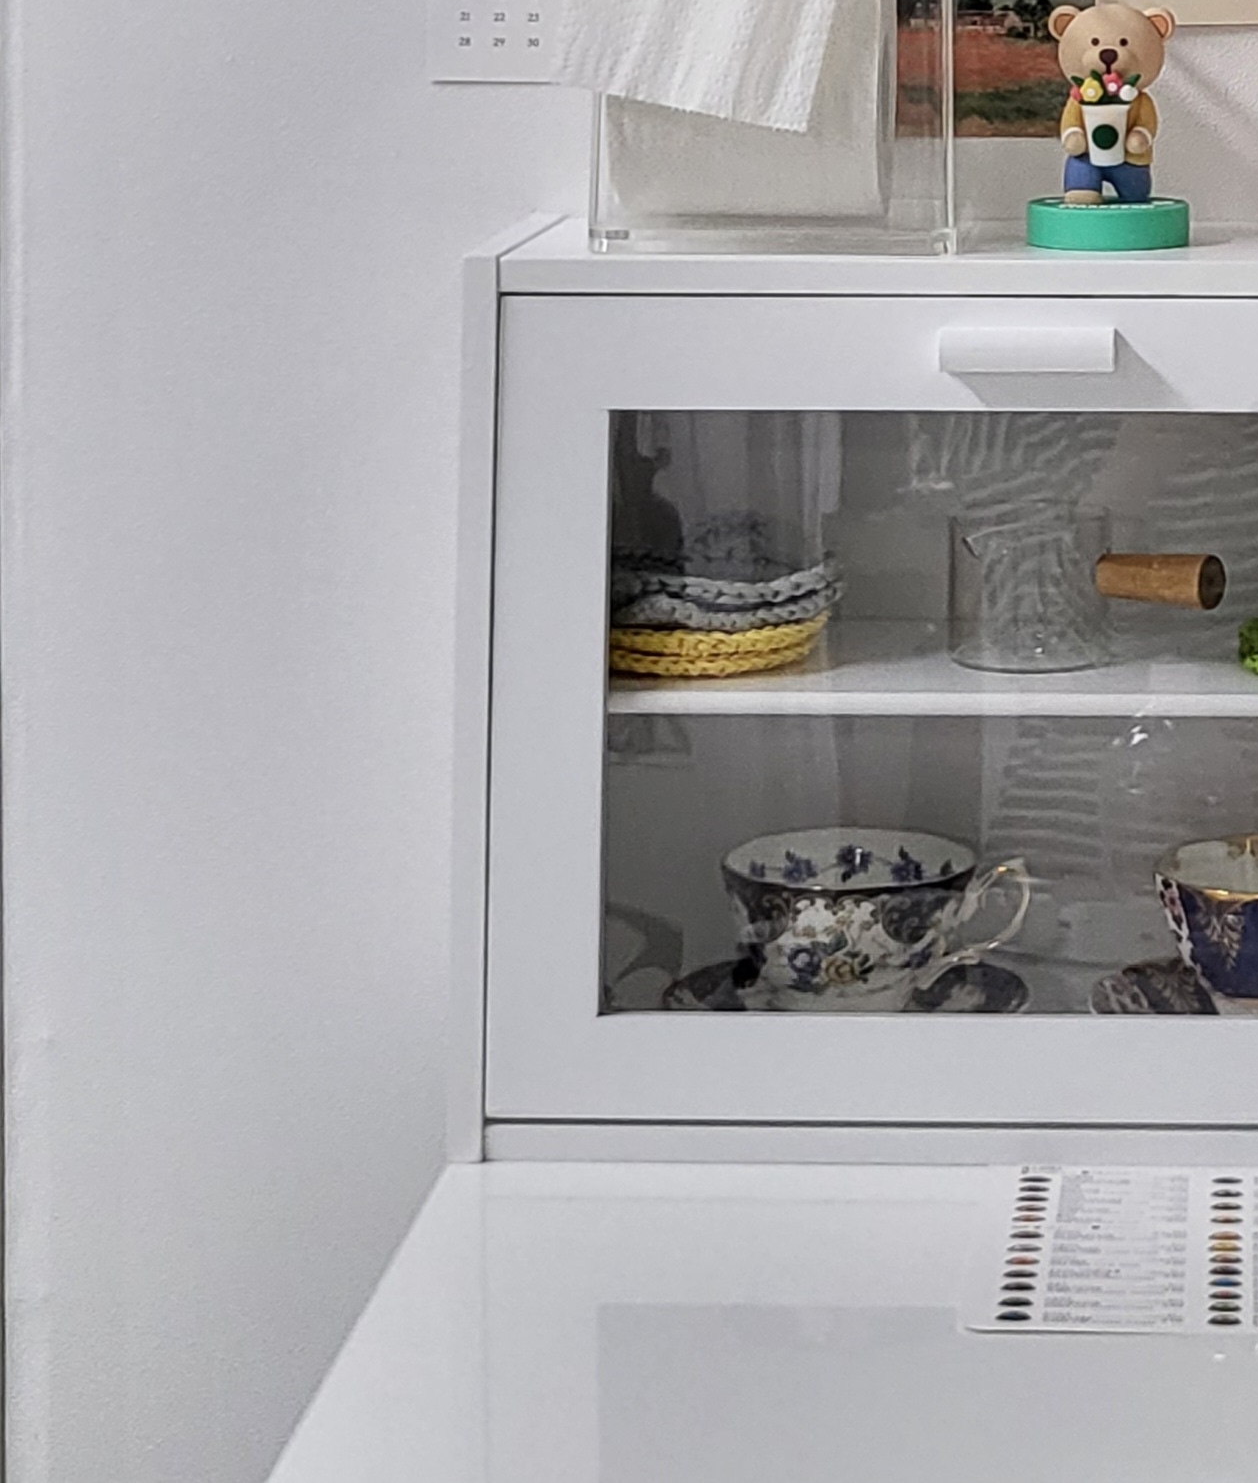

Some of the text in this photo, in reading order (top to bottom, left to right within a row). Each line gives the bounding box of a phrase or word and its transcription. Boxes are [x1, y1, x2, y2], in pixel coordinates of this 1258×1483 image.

[459, 37, 540, 47] 28 29 30
